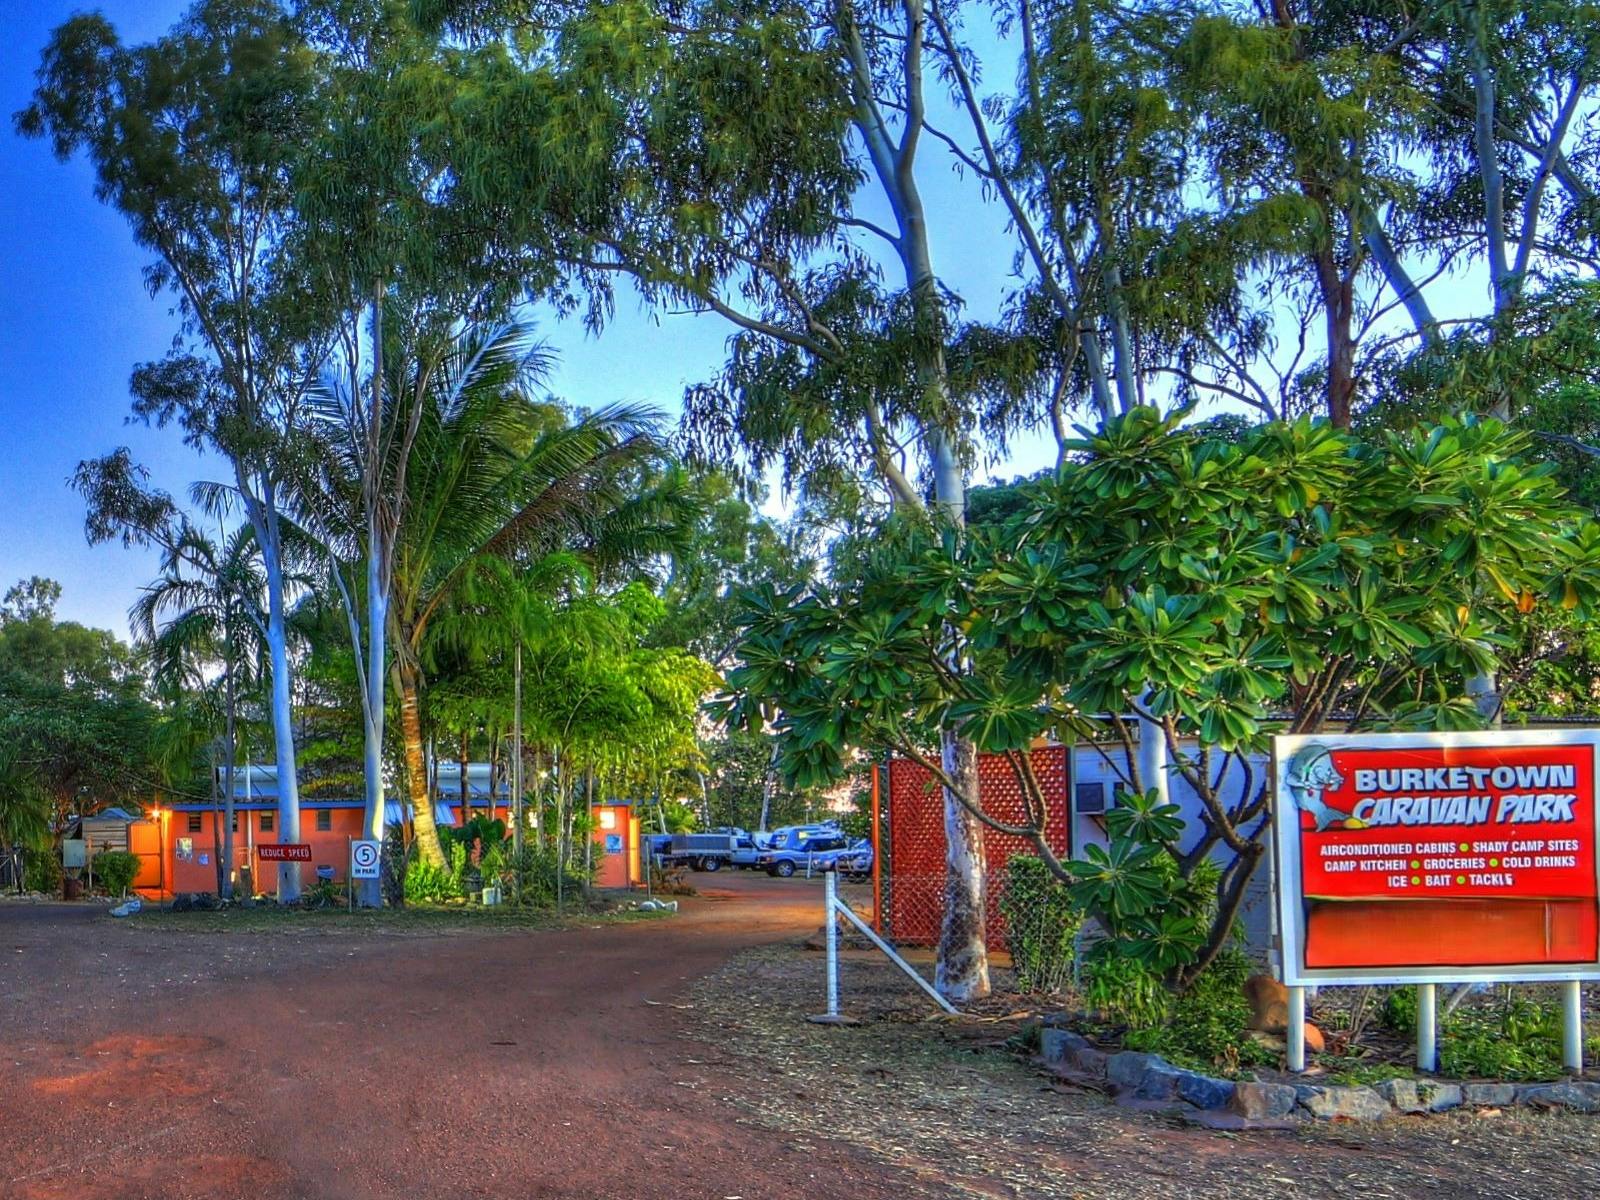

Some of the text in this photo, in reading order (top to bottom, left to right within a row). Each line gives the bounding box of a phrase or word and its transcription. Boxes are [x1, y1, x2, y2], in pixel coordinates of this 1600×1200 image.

[1354, 765, 1576, 792] BURKETOWN
[1352, 793, 1577, 828] CARAVAN PARK
[260, 847, 310, 858] REDUCE SPEED
[361, 848, 370, 862] 5
[1320, 839, 1579, 857] AIRCONDITIONED CABINS SHADY CAMP SITES
[1324, 856, 1576, 873] CAMP KITCHEN GROCERIES COLD DRINKS
[1387, 875, 1408, 888] ICE
[1424, 874, 1452, 887] BAIT
